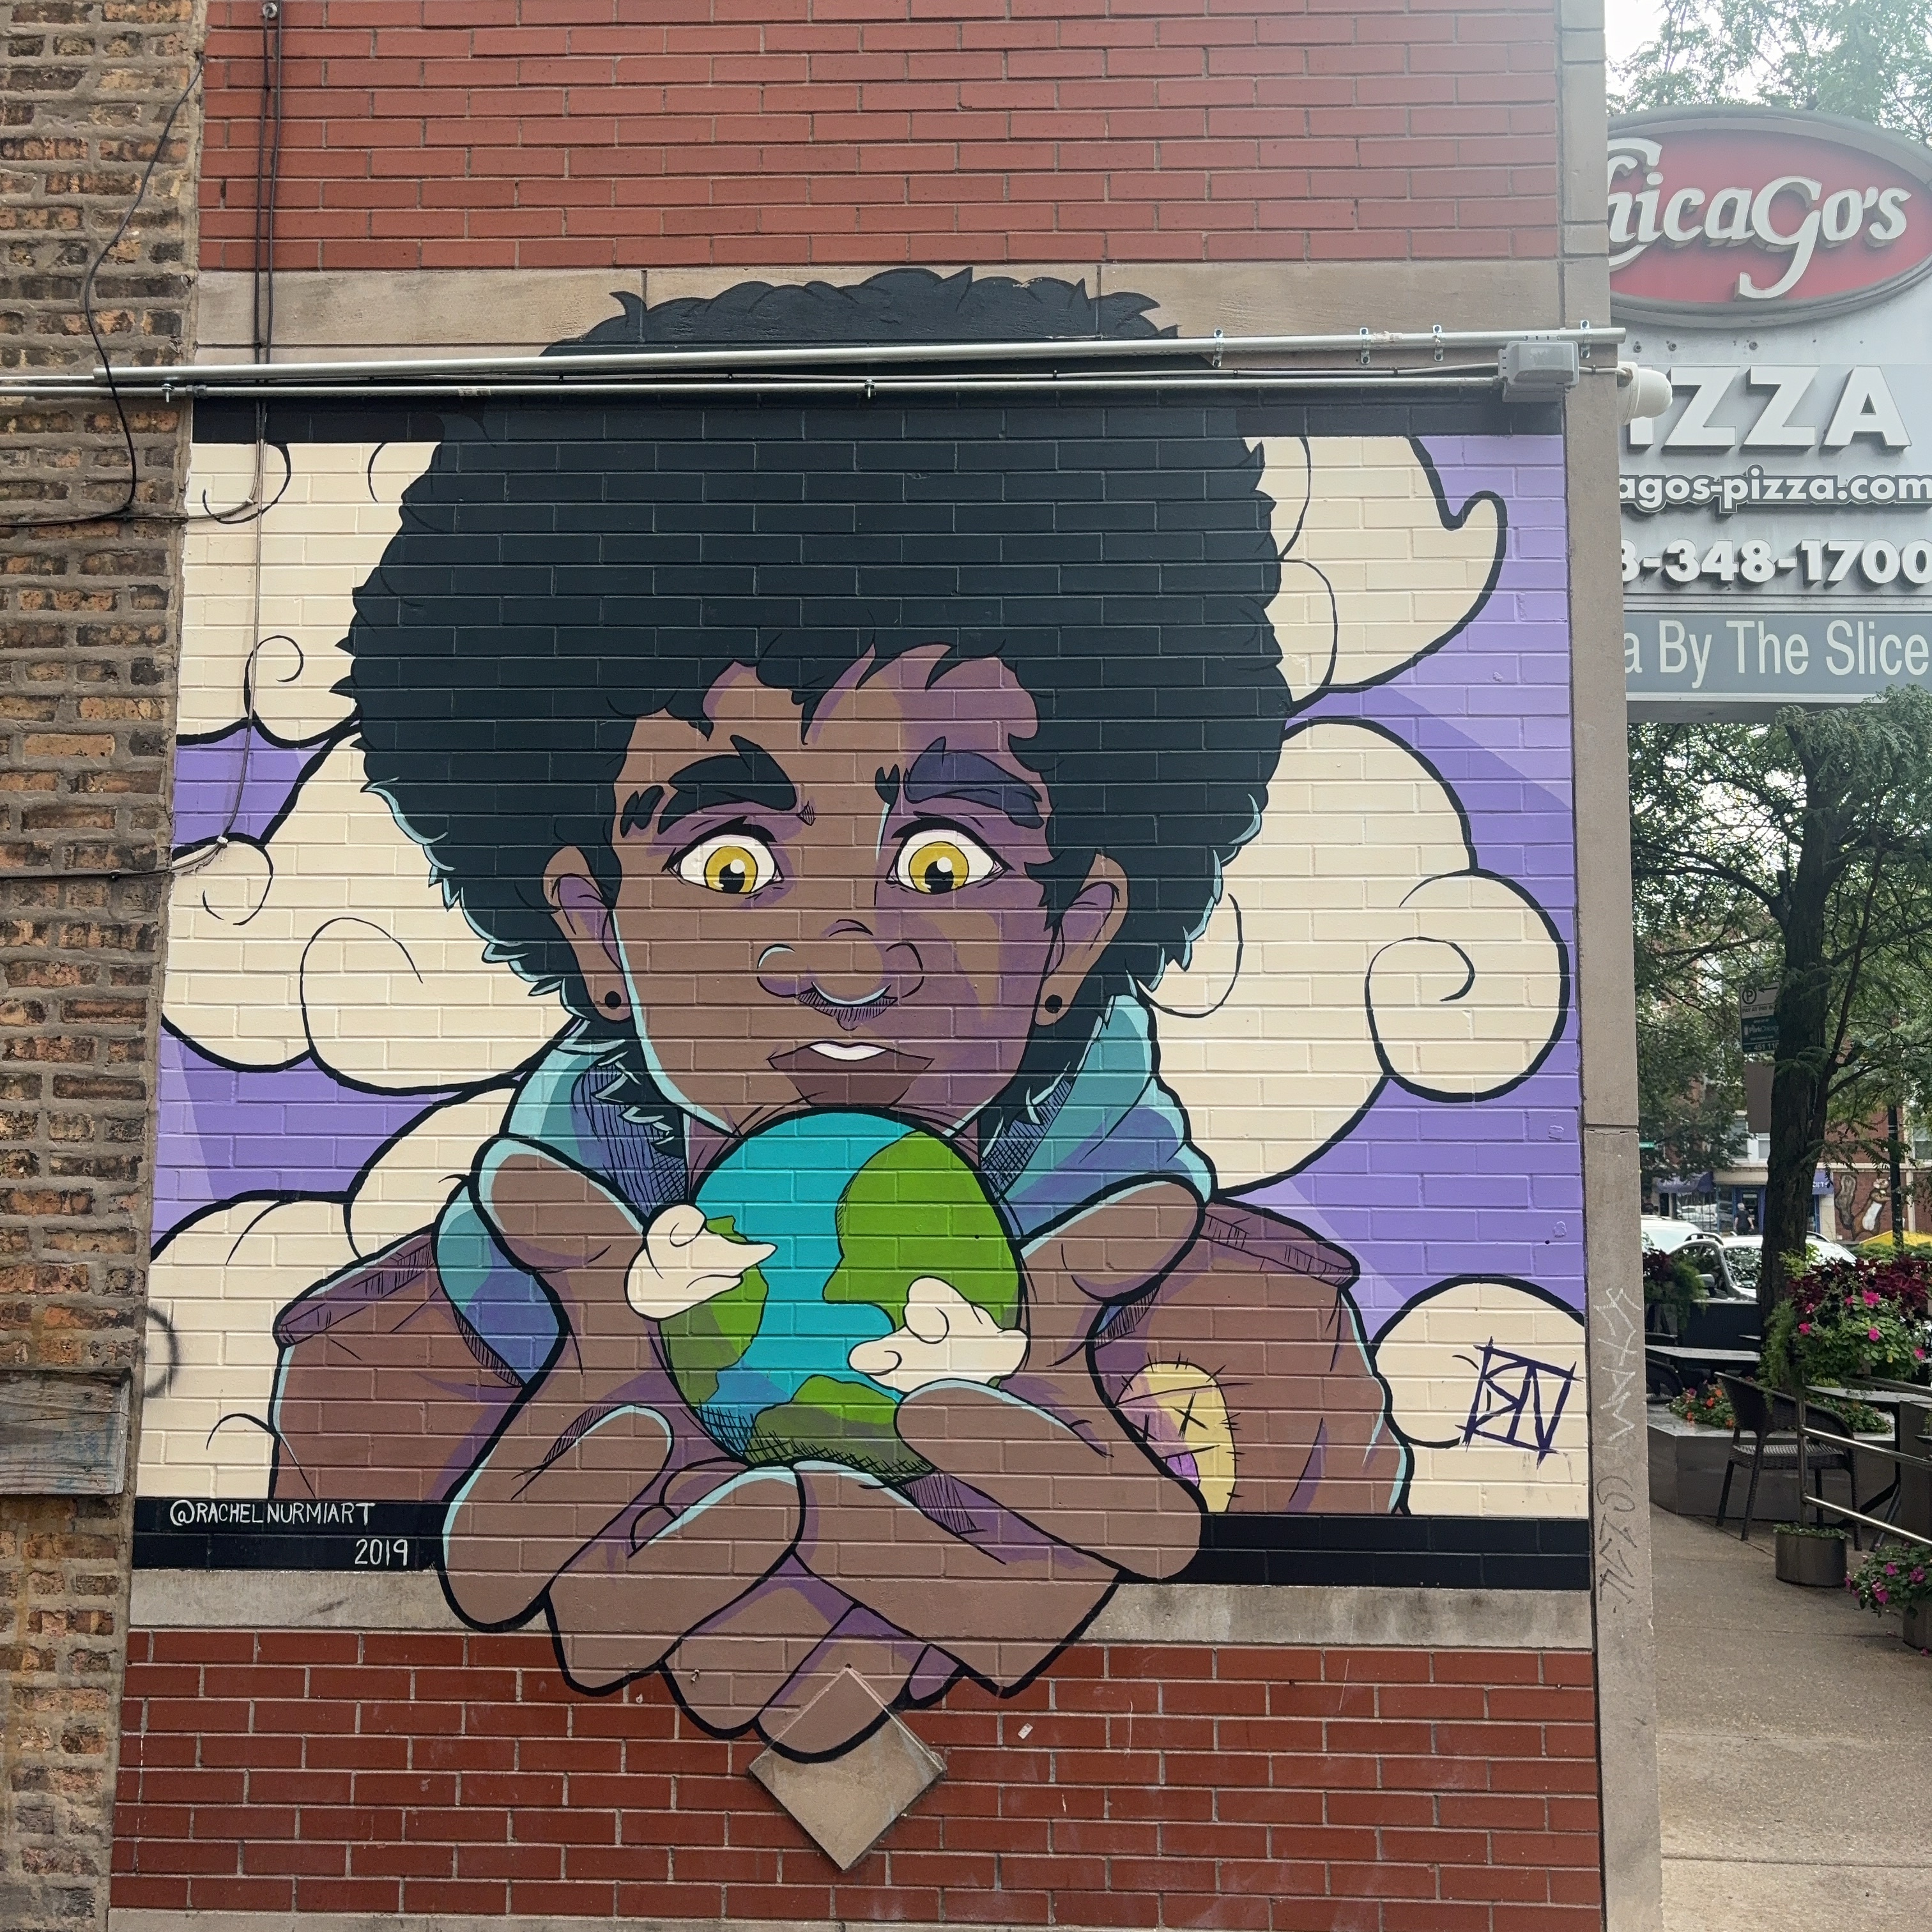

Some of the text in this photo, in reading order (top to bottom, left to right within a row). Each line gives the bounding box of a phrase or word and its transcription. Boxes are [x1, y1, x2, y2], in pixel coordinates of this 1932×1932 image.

[1619, 467, 1932, 509] agos-pizza.com
[1659, 620, 1712, 688] By
[1726, 620, 1809, 675] The
[1826, 620, 1929, 676] Slice
[355, 1538, 408, 1567] 2019
